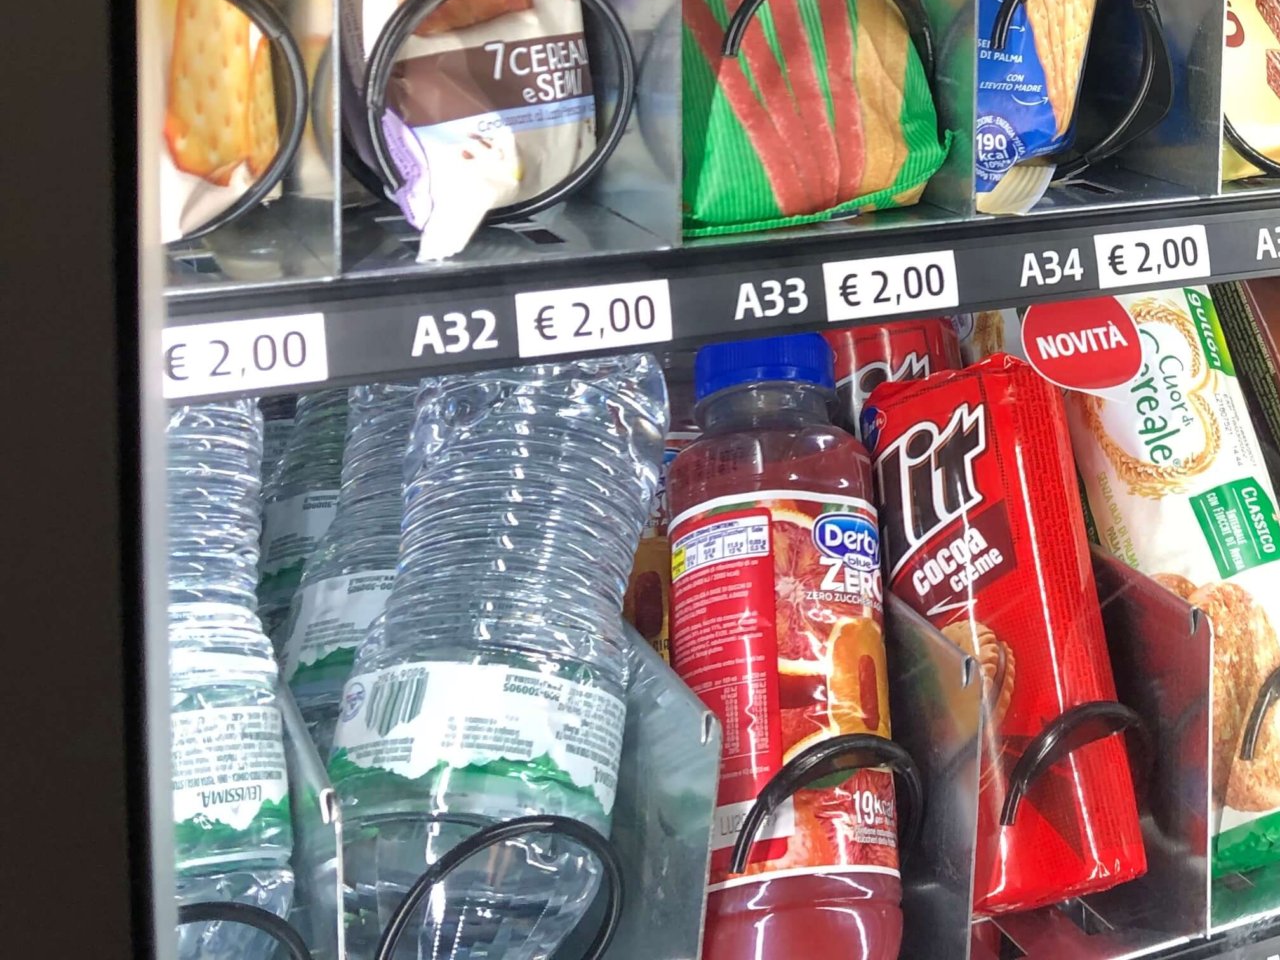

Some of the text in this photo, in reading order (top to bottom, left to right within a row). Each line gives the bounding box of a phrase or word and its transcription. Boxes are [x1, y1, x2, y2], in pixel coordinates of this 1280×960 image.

[484, 41, 506, 81] 7
[980, 50, 1023, 64] DI PALMA
[522, 86, 538, 104] e
[980, 81, 1043, 94] LIEVITO MADRE
[1006, 73, 1025, 83] CON
[976, 133, 1007, 151] 190
[978, 149, 1009, 162] kcal
[1019, 236, 1199, 287] A34 € 2,00
[734, 263, 946, 321] A33 € 2,00
[411, 294, 657, 357] A32 € 2,00
[1036, 320, 1128, 360] NOVITÀ
[1187, 292, 1222, 368] gullón
[165, 331, 308, 381] € 2,00
[1159, 354, 1188, 416] Cuor
[1206, 491, 1221, 509] CON
[1240, 485, 1277, 554] CLASSICO
[1097, 470, 1114, 501] SENZA
[1123, 539, 1141, 571] PALMA
[847, 554, 872, 569] blue
[912, 527, 988, 597] cocoa
[950, 547, 1003, 592] creme
[806, 591, 833, 603] ZERO
[853, 790, 874, 825] 19
